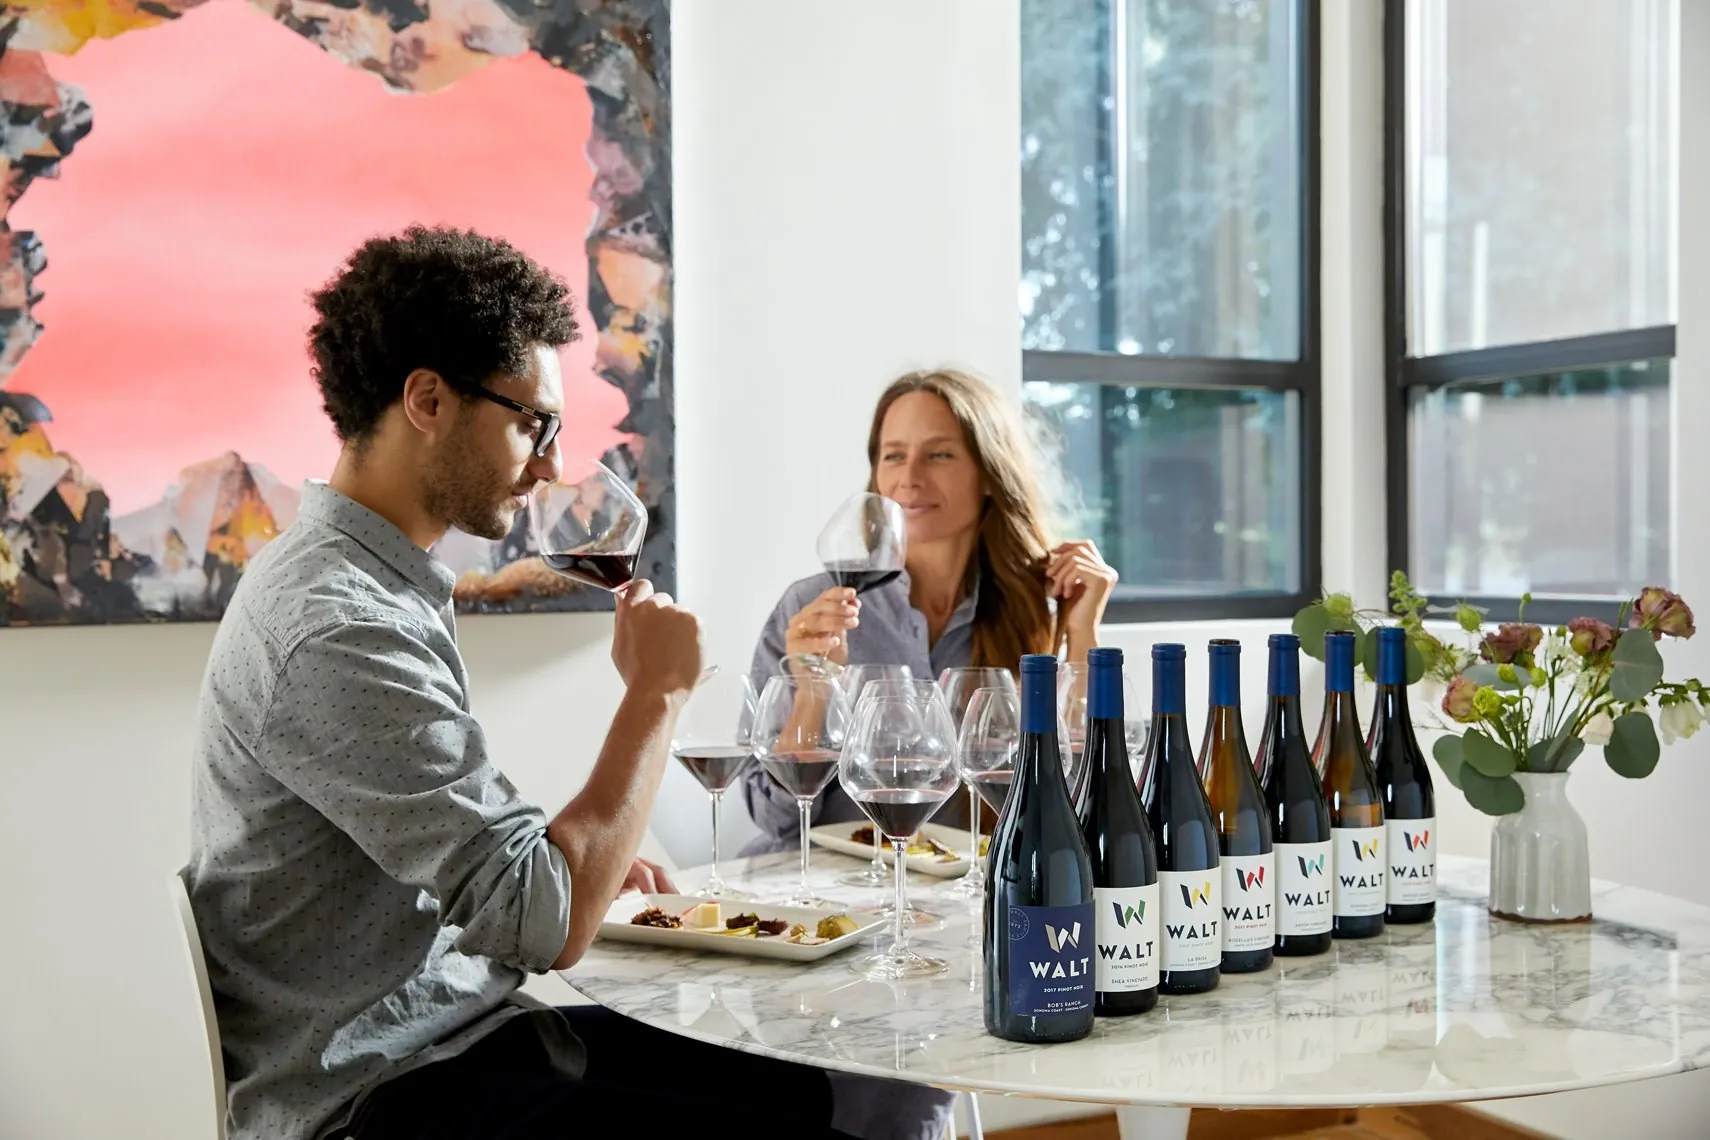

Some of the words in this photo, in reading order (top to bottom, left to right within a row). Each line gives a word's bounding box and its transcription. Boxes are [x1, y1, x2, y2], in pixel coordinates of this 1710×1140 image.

[1391, 864, 1434, 878] WALT
[1340, 873, 1383, 888] WALT
[1285, 890, 1330, 906] WALT
[1222, 904, 1271, 920] WALT
[1166, 921, 1217, 939] WALT
[1098, 941, 1153, 960] WALT
[1029, 957, 1089, 979] WALT
